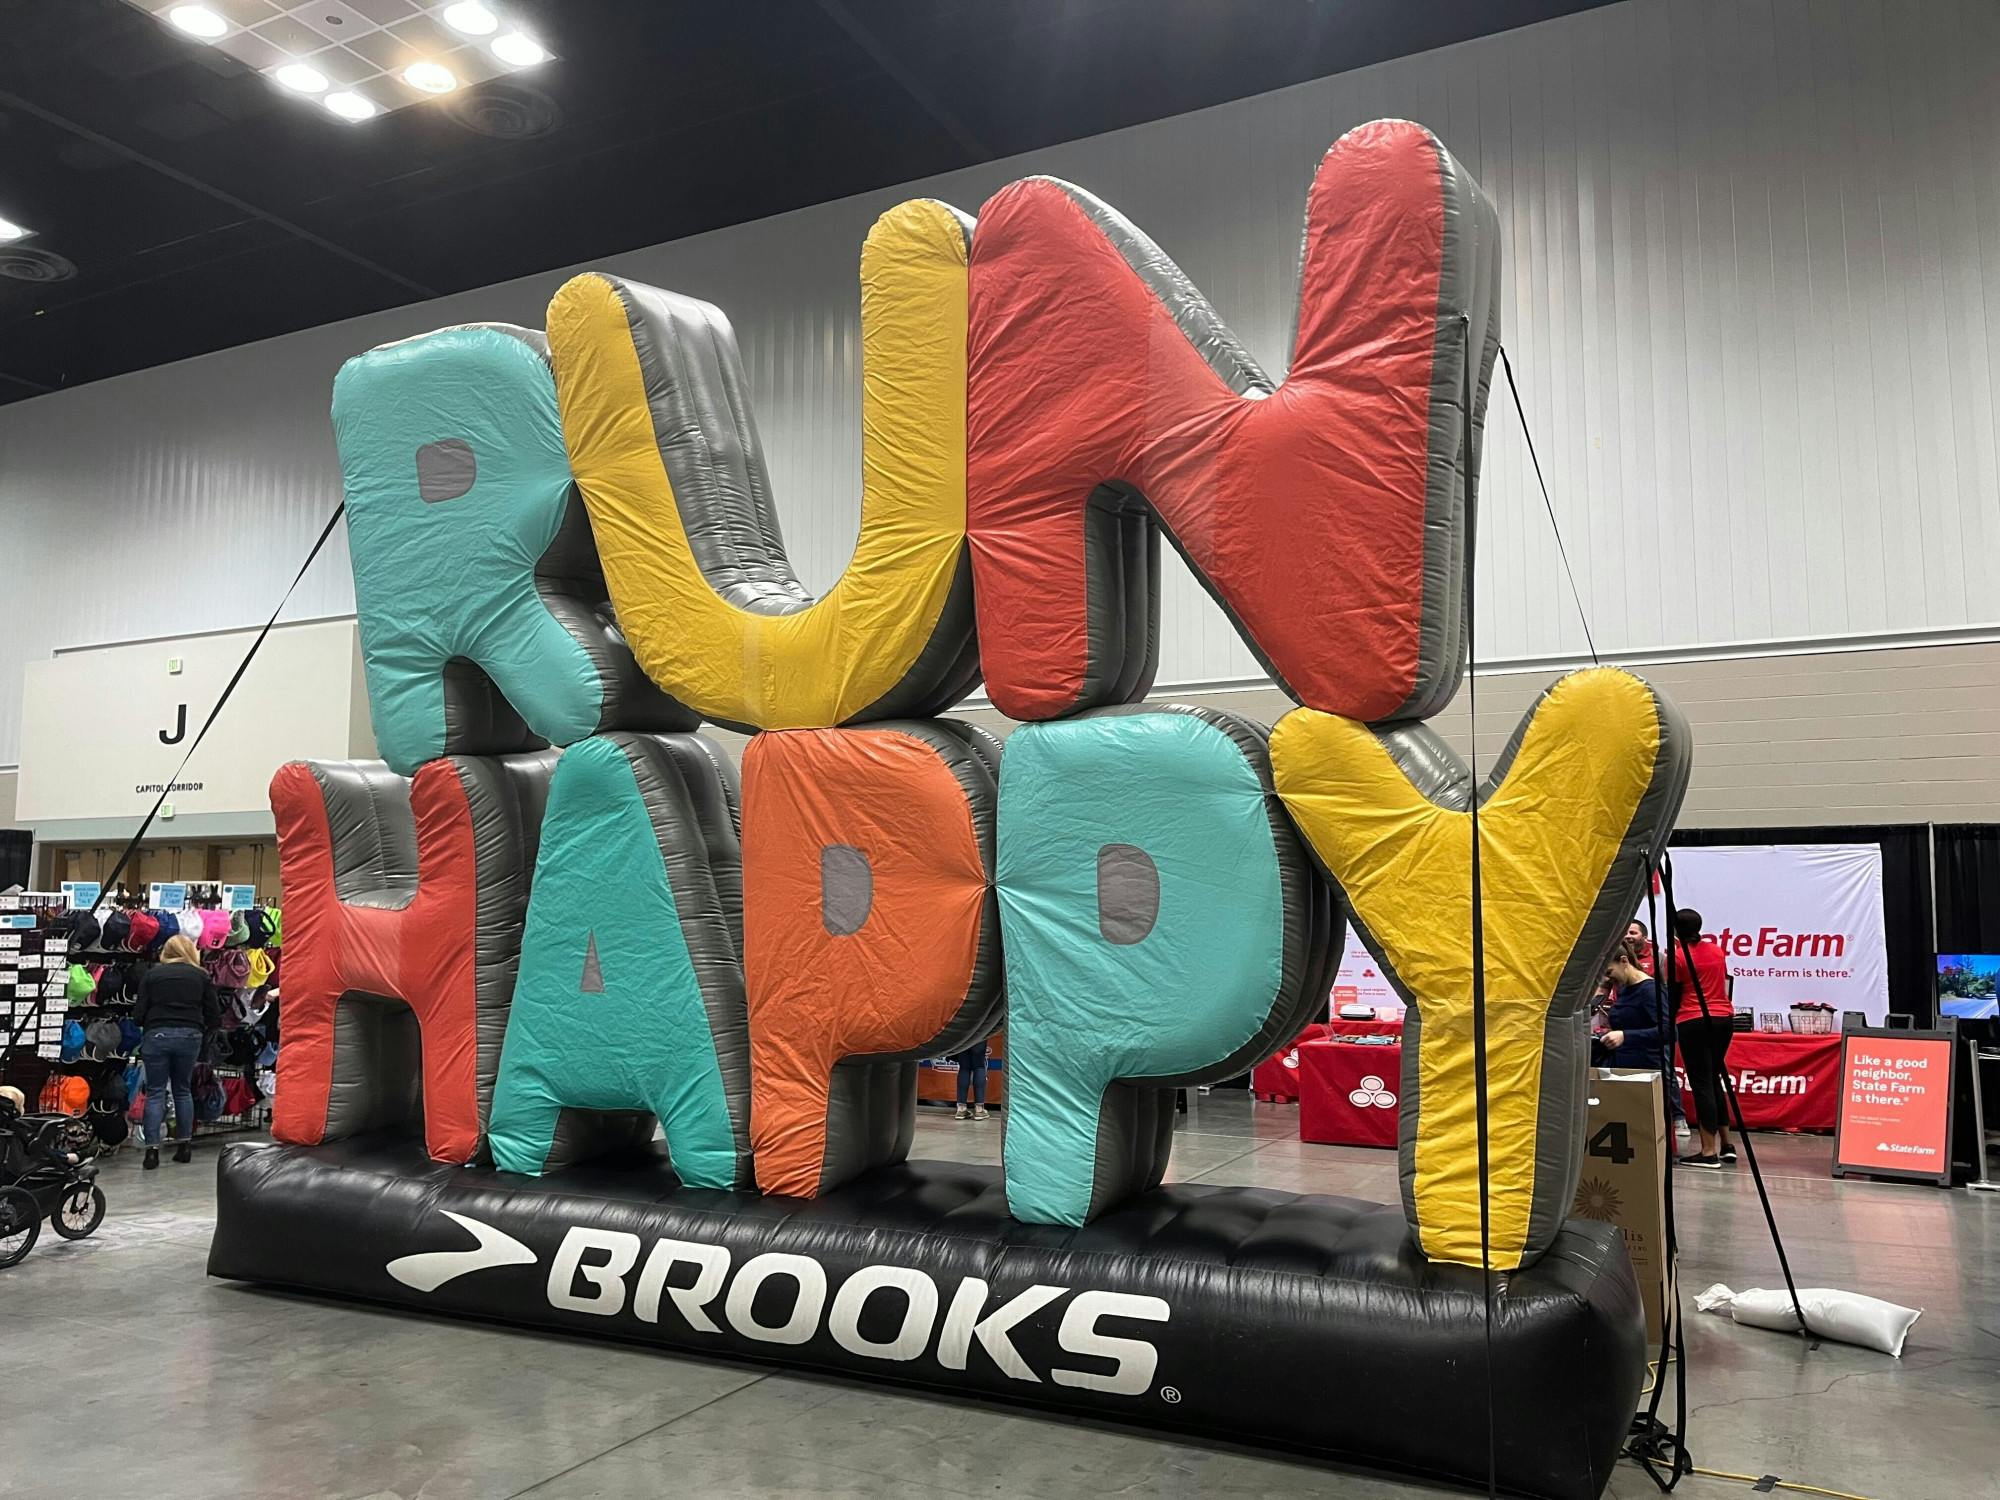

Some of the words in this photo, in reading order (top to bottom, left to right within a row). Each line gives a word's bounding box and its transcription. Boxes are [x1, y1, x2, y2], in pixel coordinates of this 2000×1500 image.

[332, 118, 1500, 772] RUN
[159, 704, 187, 745] J
[135, 784, 165, 793] CAPITOL
[268, 664, 1690, 1271] HAPPY
[1733, 967, 1765, 977] State
[1768, 967, 1799, 978] Farm
[1802, 967, 1812, 978] is
[1853, 1054, 1881, 1066] Like
[1884, 1058, 1892, 1067] a
[1895, 1058, 1928, 1069] good
[1852, 1079, 1888, 1092] State
[1891, 1082, 1925, 1094] Farm
[1851, 1092, 1862, 1103] is
[1583, 1121, 1635, 1165] 4
